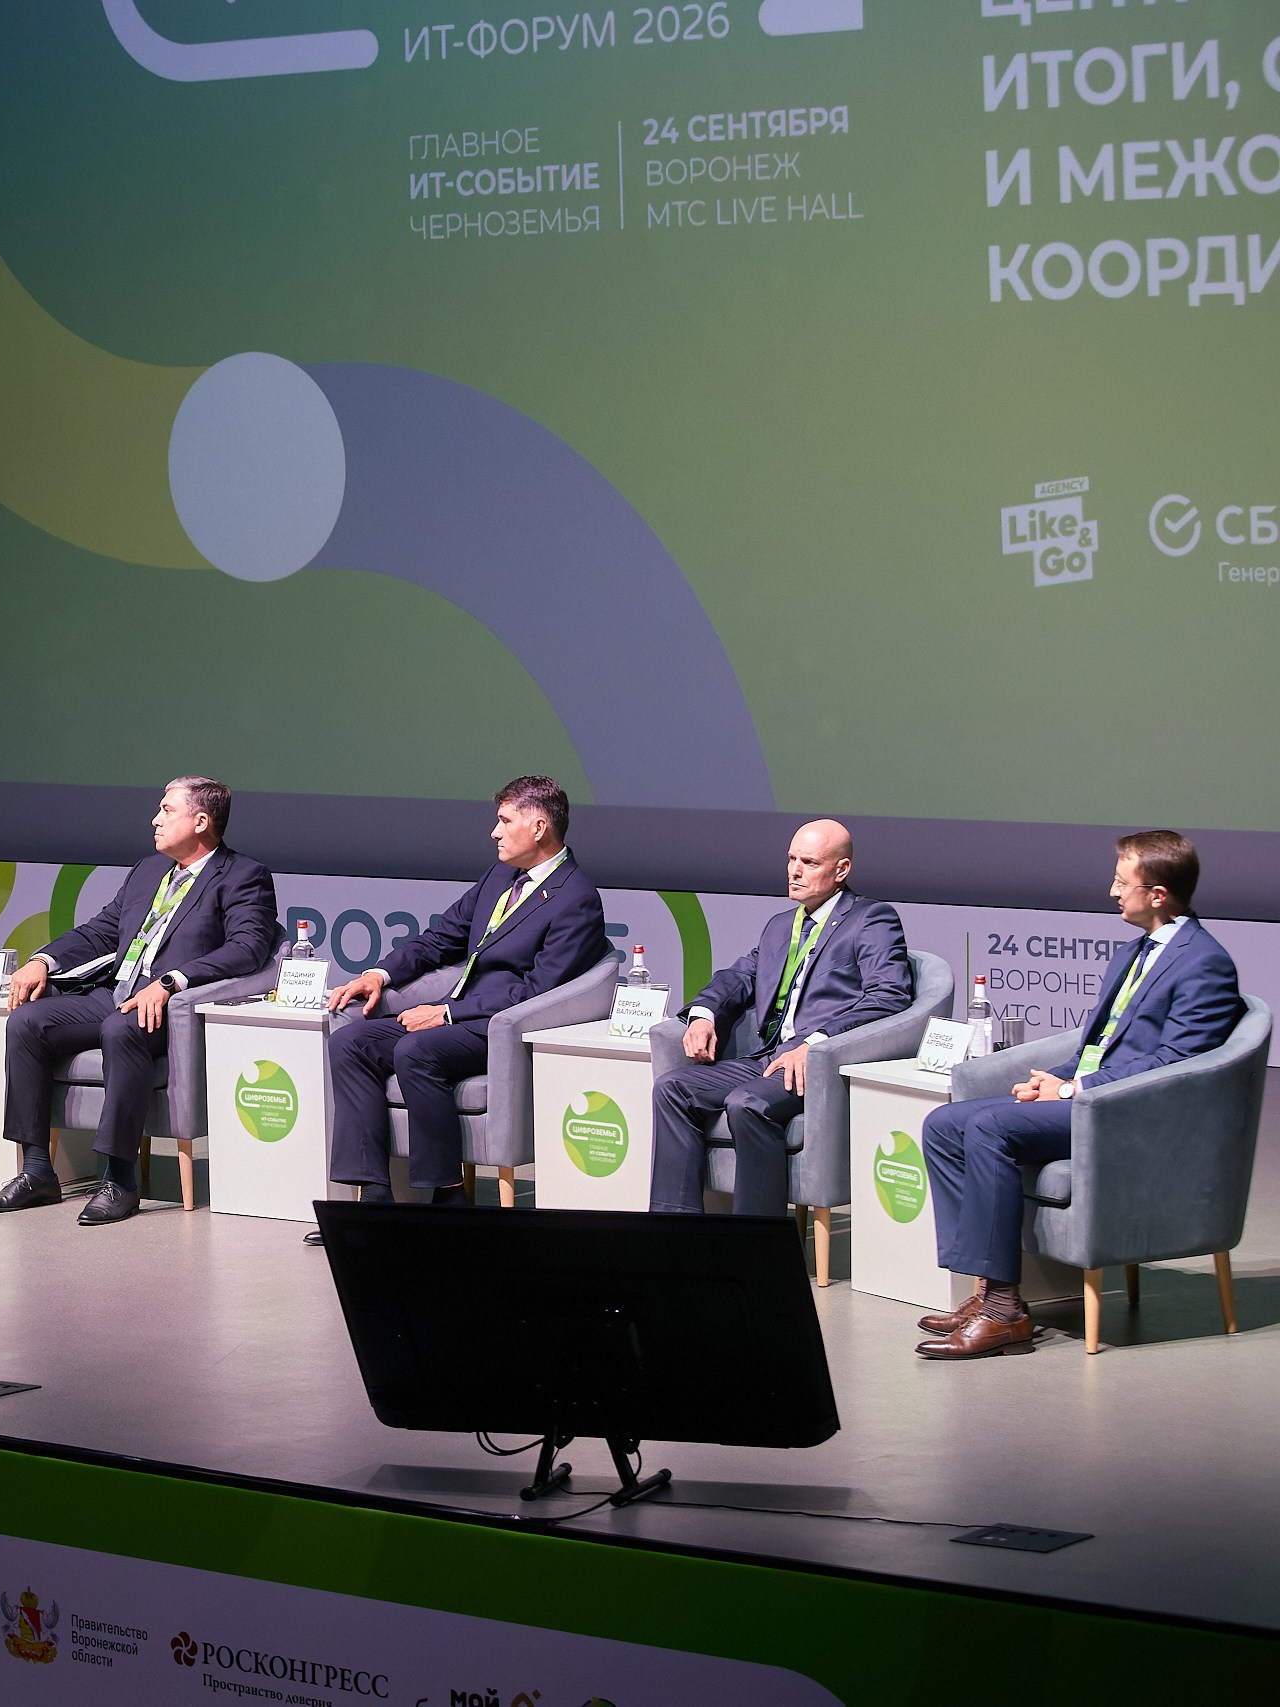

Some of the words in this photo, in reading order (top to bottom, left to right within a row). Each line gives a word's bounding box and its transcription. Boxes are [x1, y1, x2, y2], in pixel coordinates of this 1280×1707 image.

[404, 11, 615, 62] ИТ-ФОРУМ
[633, 2, 730, 45] 2026
[983, 39, 1240, 111] ИТОГИ,
[643, 117, 679, 145] 24
[687, 105, 849, 142] СЕНТЯБРЯ
[409, 127, 540, 160] ГЛАВНОЕ
[409, 163, 600, 199] ИТ-СОБЫТИЕ
[646, 151, 801, 187] ВОРОНЕЖ
[985, 148, 1032, 208] И
[1058, 134, 1280, 204] МЕЖО
[409, 205, 600, 240] ЧЕРНОЗЕМЬЯ
[647, 200, 706, 229] МТС
[719, 195, 777, 225] LIVE
[787, 192, 864, 222] HALL
[1039, 479, 1085, 495] AGENCY
[1008, 509, 1078, 545] Like
[1078, 527, 1093, 547] &
[1039, 546, 1086, 577] Go
[988, 934, 1018, 956] 24
[281, 978, 313, 986] ПУШКАРЕВ
[283, 971, 316, 979] ВЛАДИМИР
[990, 968, 1104, 996] ВОРОНЕ
[616, 1007, 653, 1018] ВАЛУЙСКИХ
[618, 1000, 641, 1008] СЕРГЕЙ
[1050, 1006, 1094, 1029] LIV
[244, 1093, 287, 1104] ЦИФРОЗЕМЬЕ
[572, 1125, 617, 1138] ЦИФРОЗЕМЬЕ
[71, 1614, 148, 1641] Правительство
[71, 1631, 139, 1657] Воронежской
[71, 1649, 113, 1668] области
[202, 1641, 389, 1699] РОСКОНГРЕСС
[202, 1673, 283, 1701] Пространство
